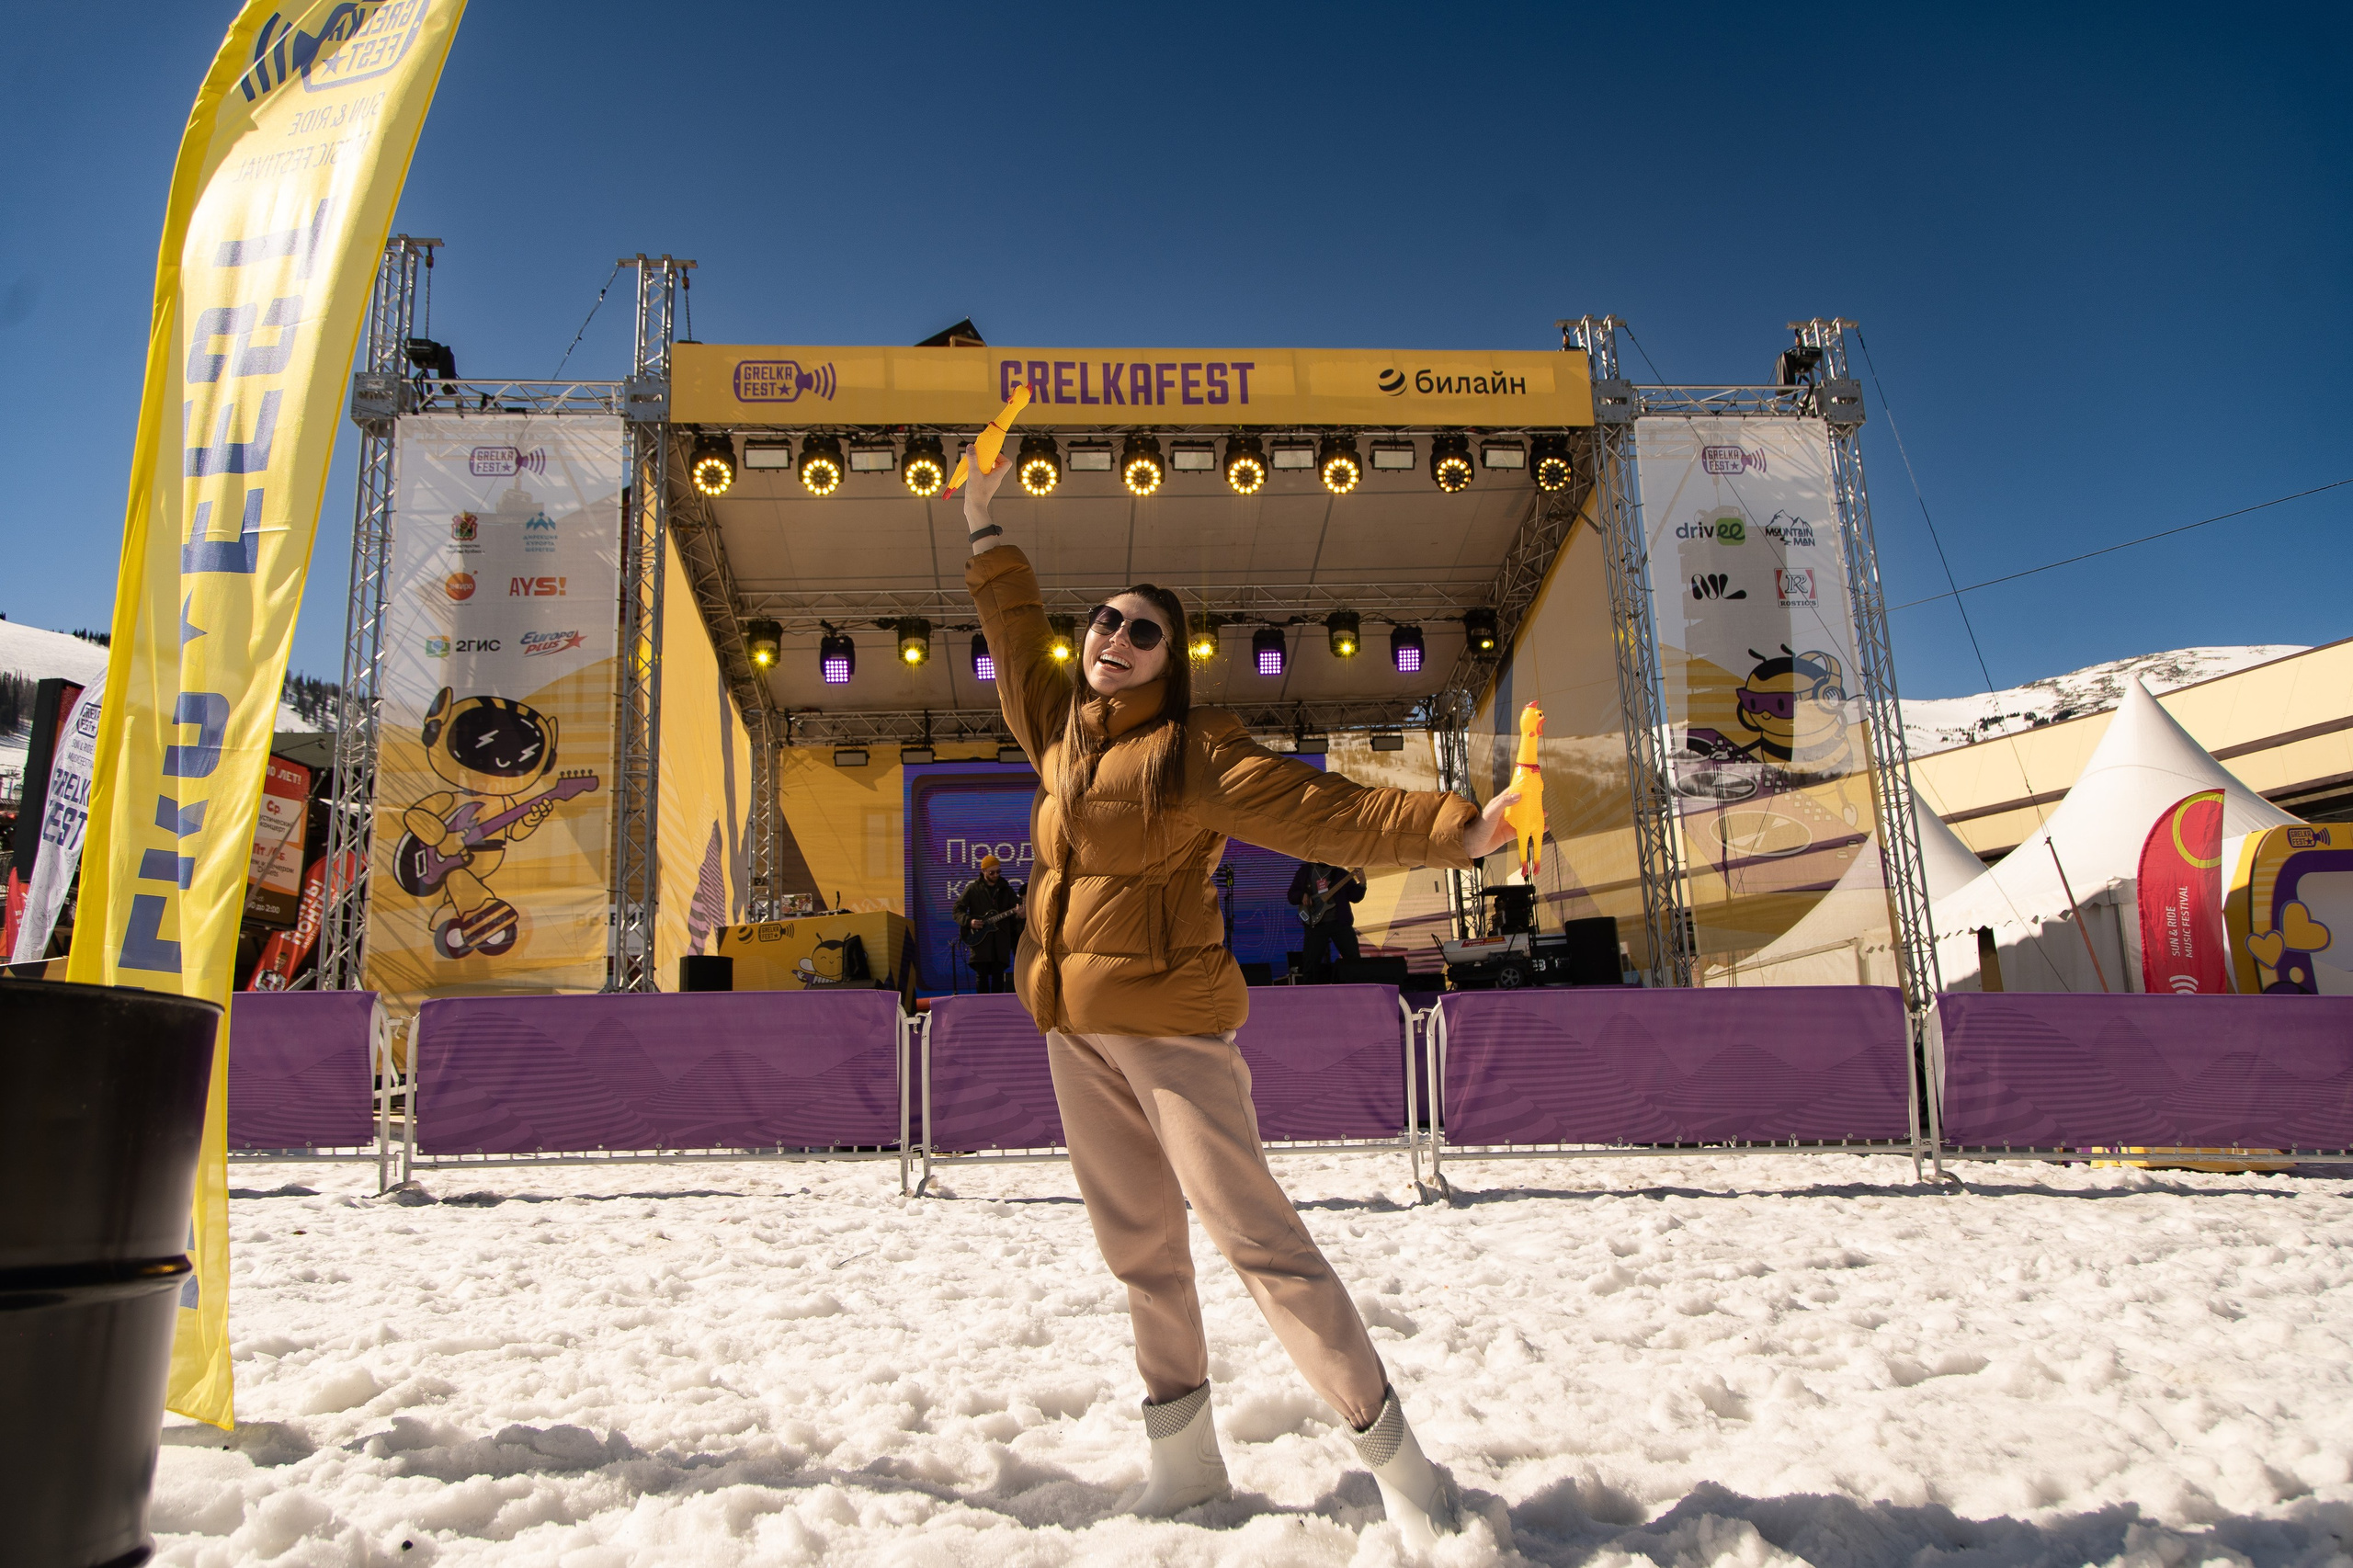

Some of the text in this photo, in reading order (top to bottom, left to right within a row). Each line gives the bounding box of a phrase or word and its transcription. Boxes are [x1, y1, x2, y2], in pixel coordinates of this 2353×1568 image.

[743, 365, 792, 381] GRELKA
[743, 381, 779, 396] FEST
[1000, 359, 1256, 406] GRELKAFEST
[1415, 369, 1527, 395] билайн
[476, 450, 515, 461] GRELKA
[1708, 449, 1740, 460] GRELKA
[476, 461, 502, 472] FEST
[1709, 460, 1730, 471] FEST
[1676, 522, 1745, 540] drivee
[1793, 538, 1815, 547] MAN
[509, 576, 567, 597] AYS!
[455, 640, 501, 653] 2ГИС
[2290, 829, 2313, 838] GRELKA
[2291, 837, 2307, 846] FEST
[2166, 905, 2177, 926] RIDE
[2178, 885, 2193, 959] MUSIC FESTIVAL
[761, 932, 775, 941] FEST
[2171, 937, 2181, 957] SUN
